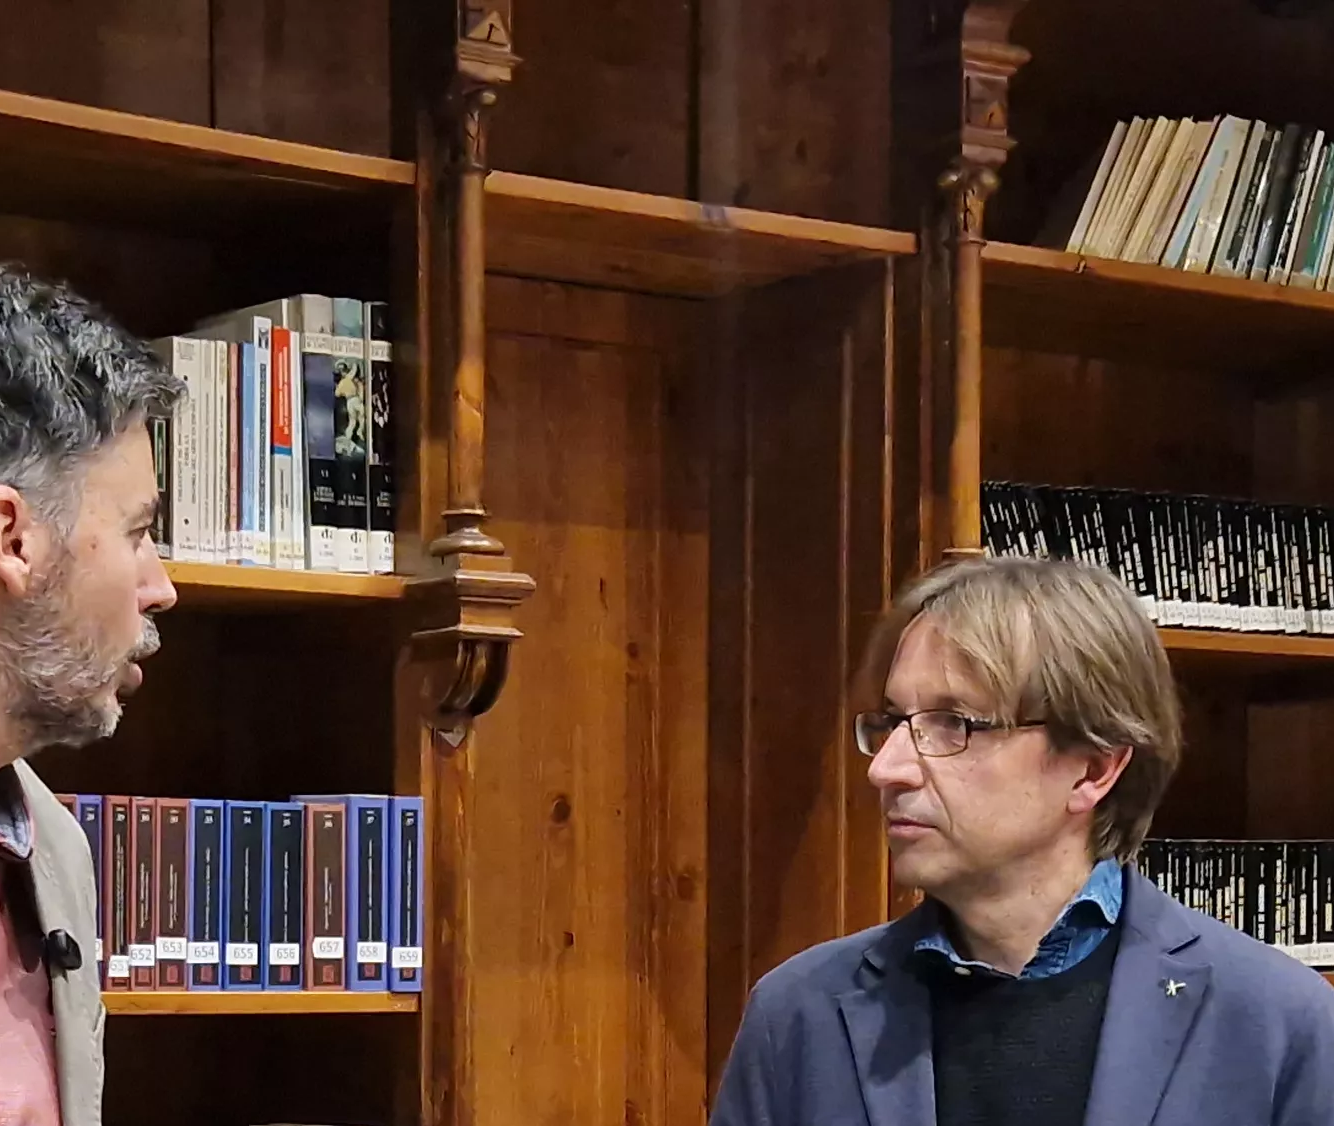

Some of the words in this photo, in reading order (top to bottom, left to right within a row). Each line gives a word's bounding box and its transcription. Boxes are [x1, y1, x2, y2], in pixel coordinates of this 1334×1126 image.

[163, 942, 183, 954] 653
[194, 947, 215, 958] 654
[319, 941, 340, 953] 657
[359, 946, 379, 957] 658
[131, 950, 152, 961] 652
[233, 948, 254, 959] 655
[276, 949, 295, 960] 656
[399, 951, 418, 962] 659
